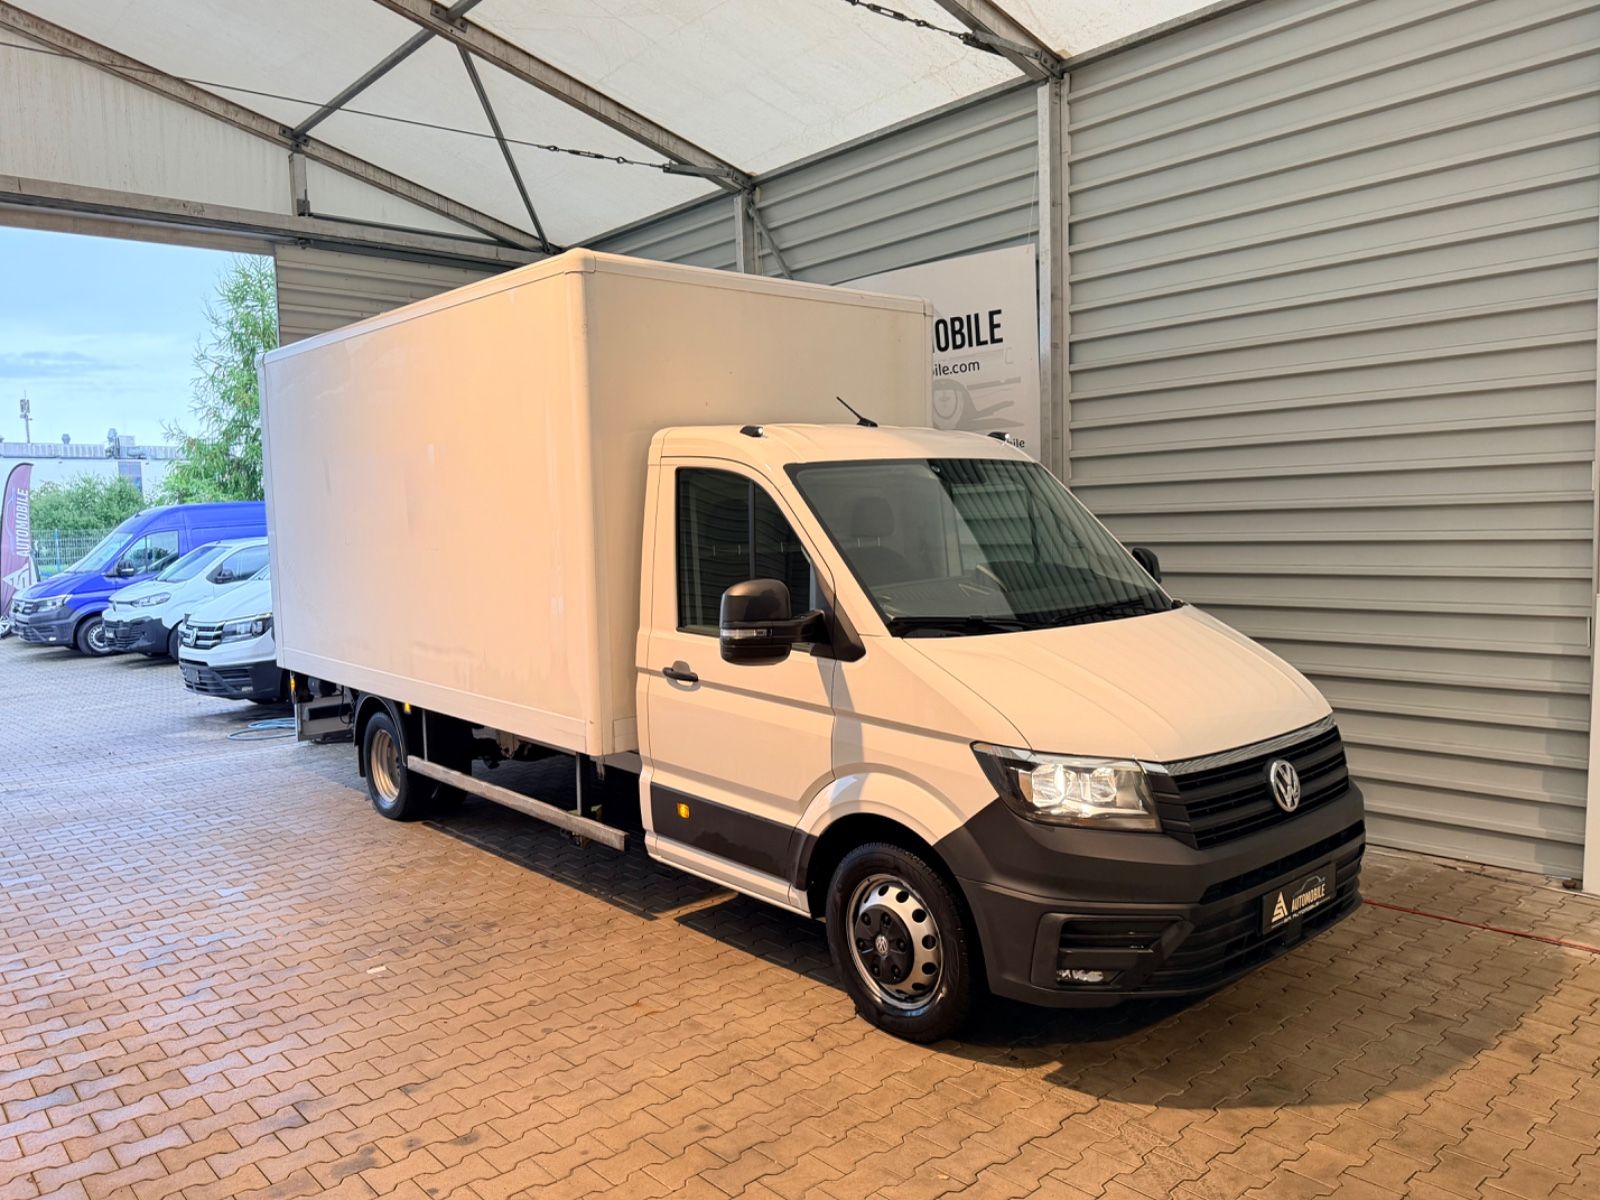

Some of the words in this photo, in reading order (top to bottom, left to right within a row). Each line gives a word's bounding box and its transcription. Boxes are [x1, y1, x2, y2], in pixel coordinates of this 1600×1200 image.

[932, 309, 1003, 353] OBILE
[932, 361, 980, 376] ile.com
[16, 487, 30, 557] AUTOMOBILE
[1291, 883, 1326, 913] AUTOMOBILE
